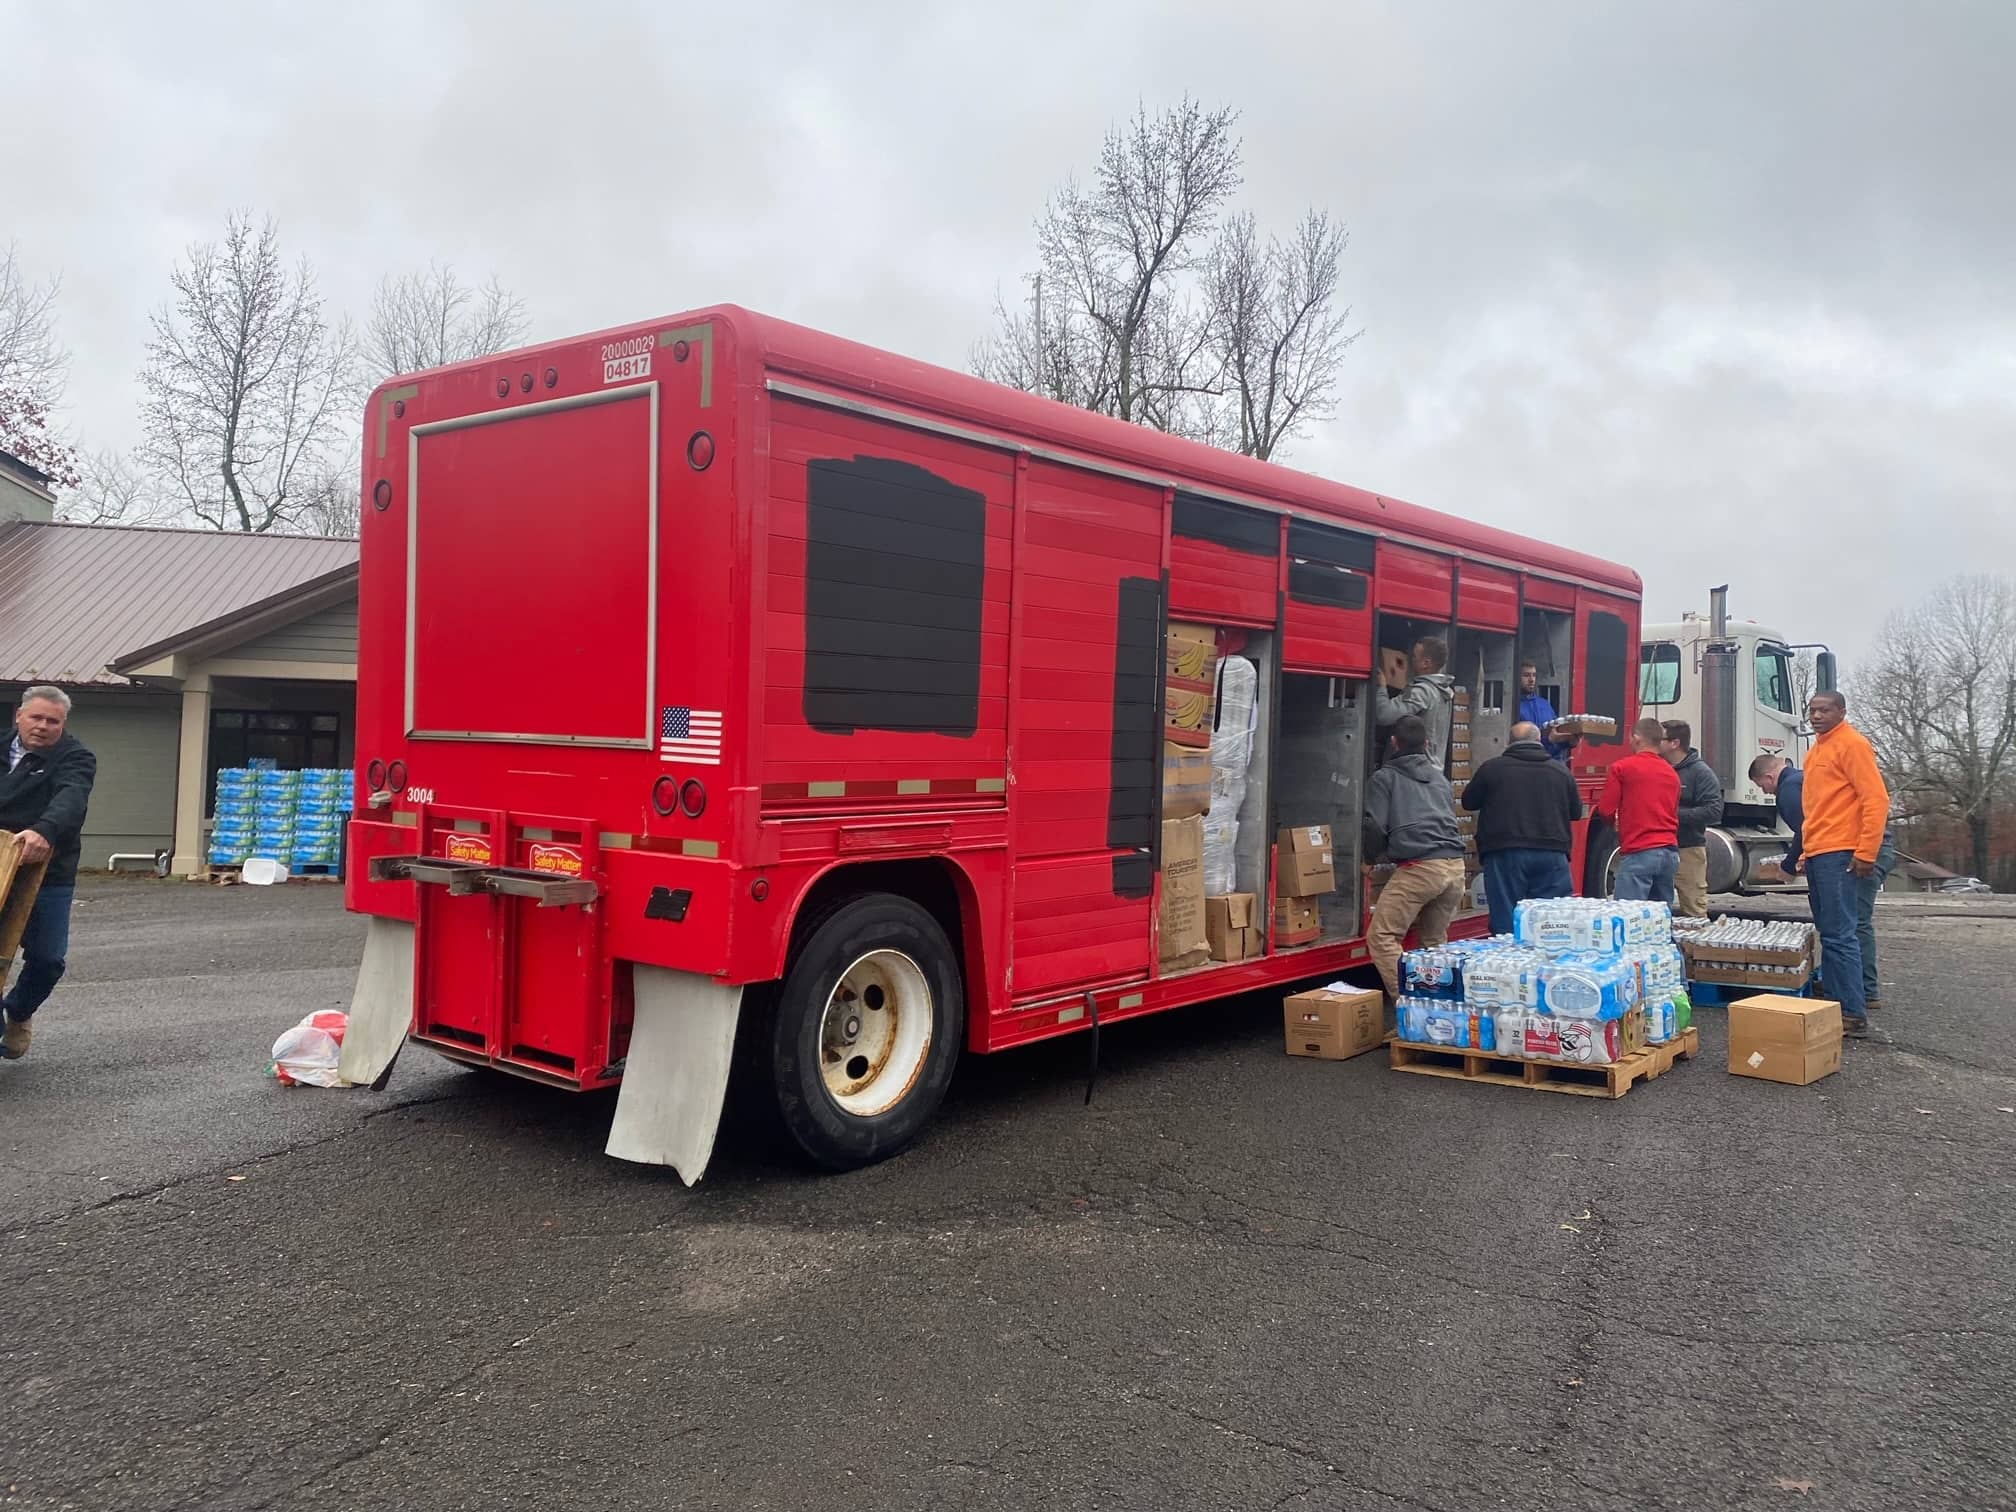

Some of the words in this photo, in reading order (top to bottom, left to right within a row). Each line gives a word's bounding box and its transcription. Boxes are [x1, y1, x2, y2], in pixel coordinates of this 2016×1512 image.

[601, 335, 654, 361] 20000029
[607, 357, 649, 379] 04817
[407, 786, 433, 804] 3004
[450, 846, 470, 861] Safety
[534, 855, 556, 872] Safety
[1512, 1029, 1520, 1038] 32
